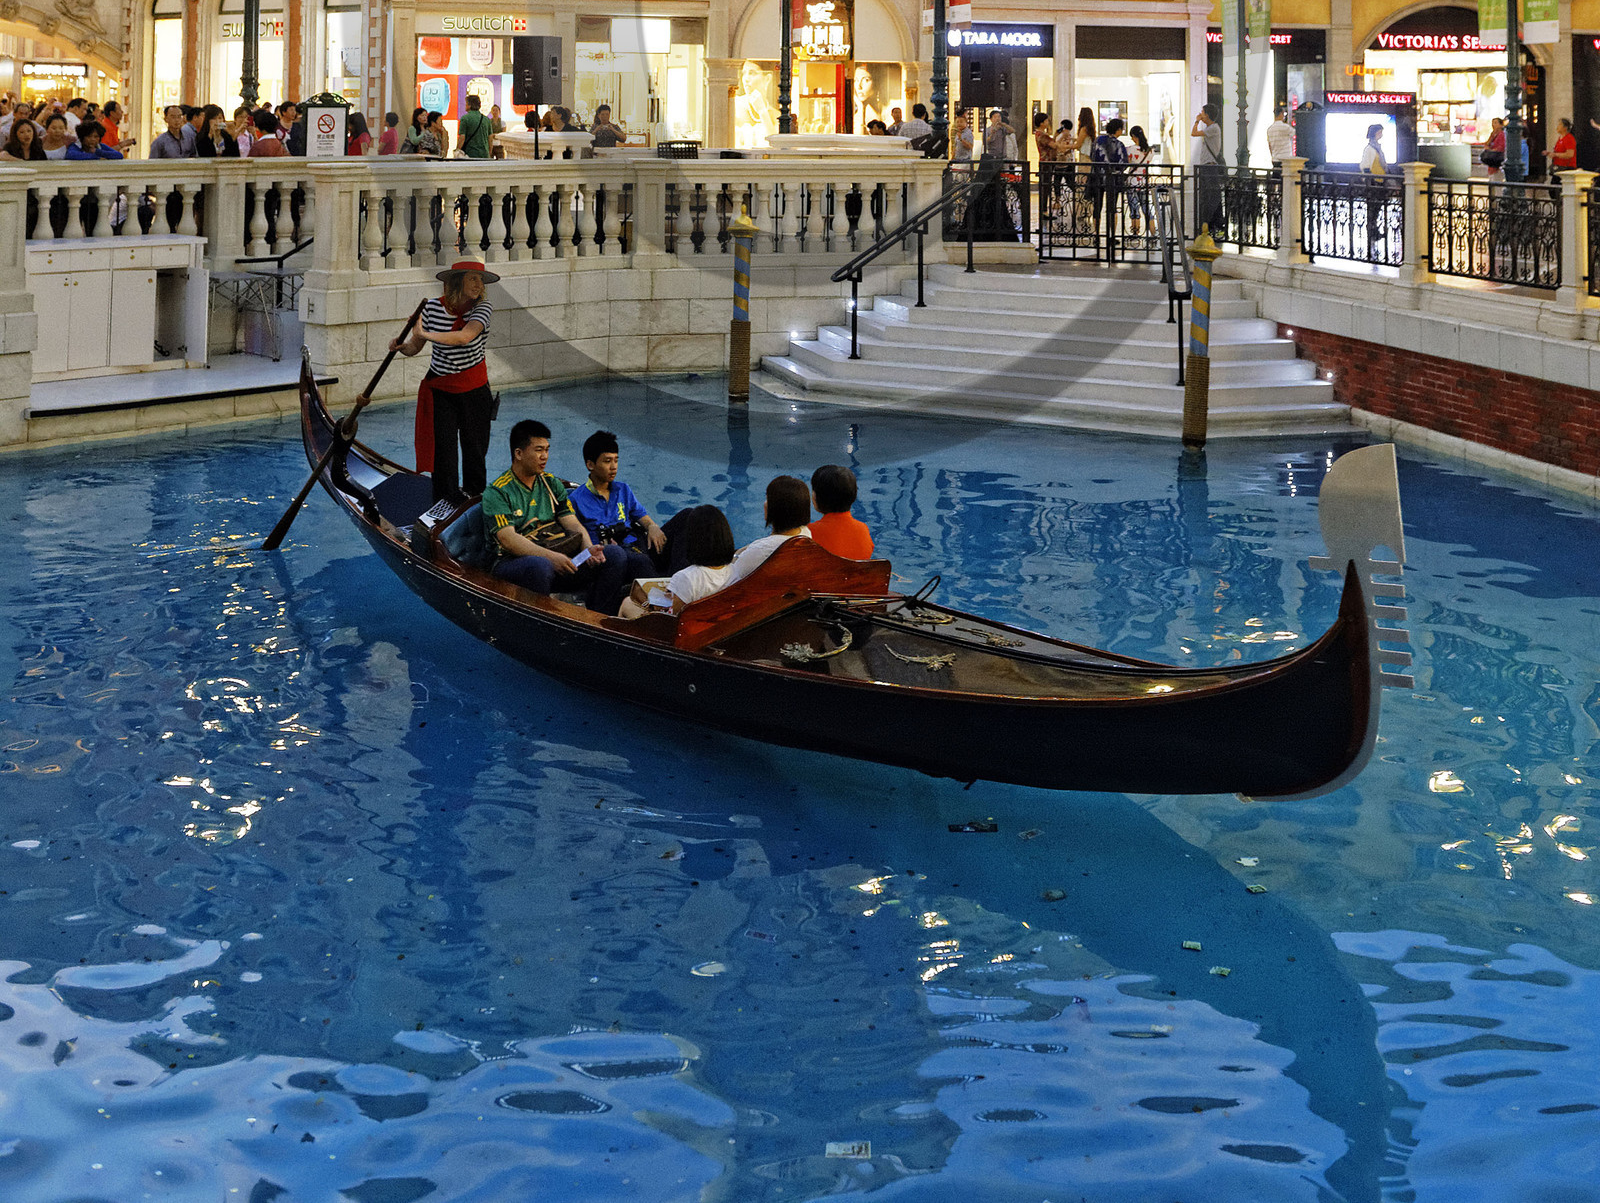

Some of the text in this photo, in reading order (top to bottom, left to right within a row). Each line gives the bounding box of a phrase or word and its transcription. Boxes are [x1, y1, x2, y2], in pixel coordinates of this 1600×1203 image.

[222, 18, 275, 38] swch
[442, 14, 514, 31] swatch
[1377, 33, 1458, 49] VICTORIA'S
[1326, 93, 1412, 104] VICTORIA'S SECRET
